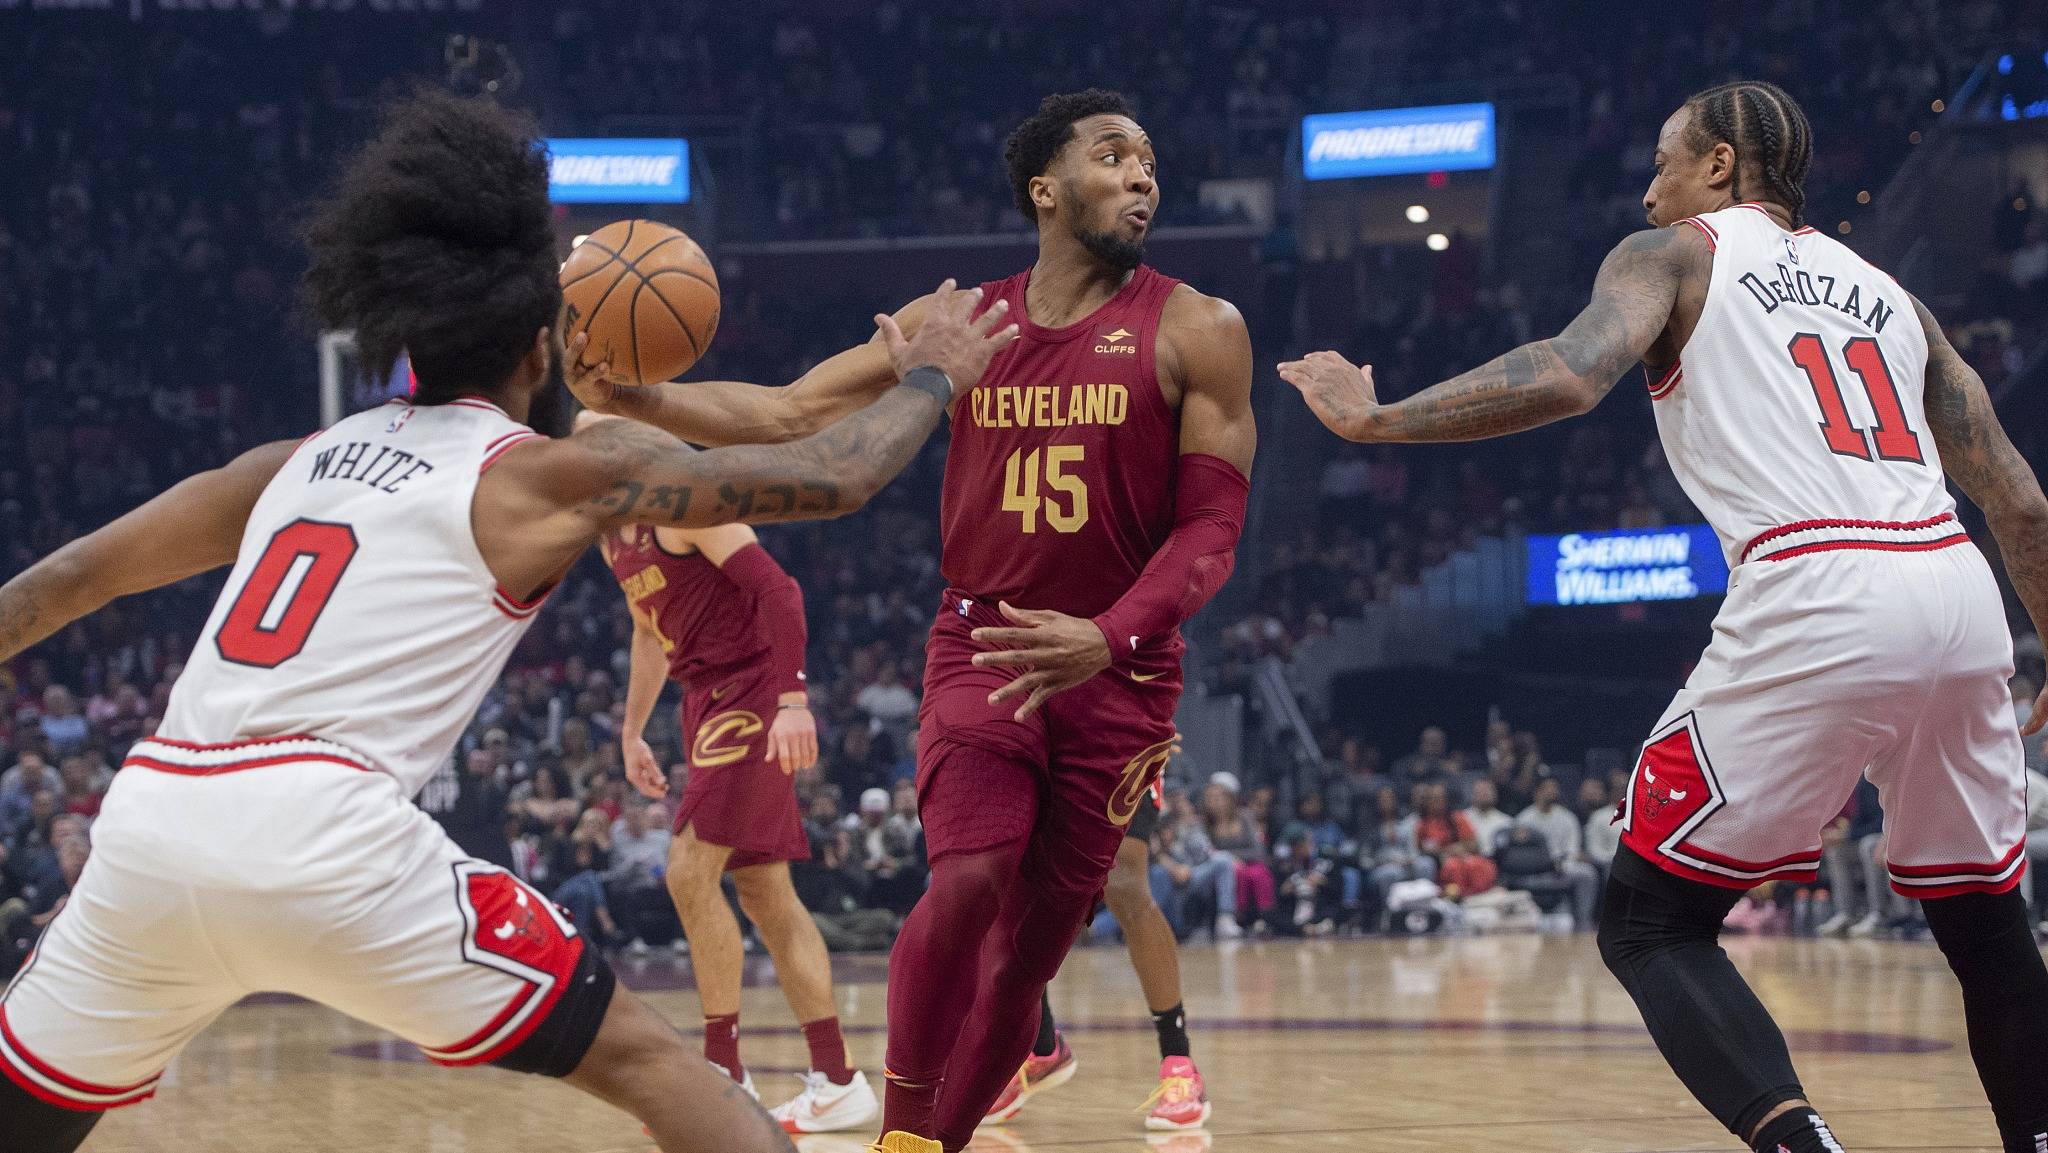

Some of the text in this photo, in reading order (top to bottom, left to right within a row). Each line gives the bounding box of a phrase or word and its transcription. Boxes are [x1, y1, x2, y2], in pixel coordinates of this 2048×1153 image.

[1094, 344, 1136, 354] CLIFFS
[971, 384, 1129, 428] CLEVELAND
[1787, 331, 1926, 466] 11
[308, 442, 434, 493] WHITE
[1001, 445, 1089, 534] 45
[214, 516, 359, 669] 0
